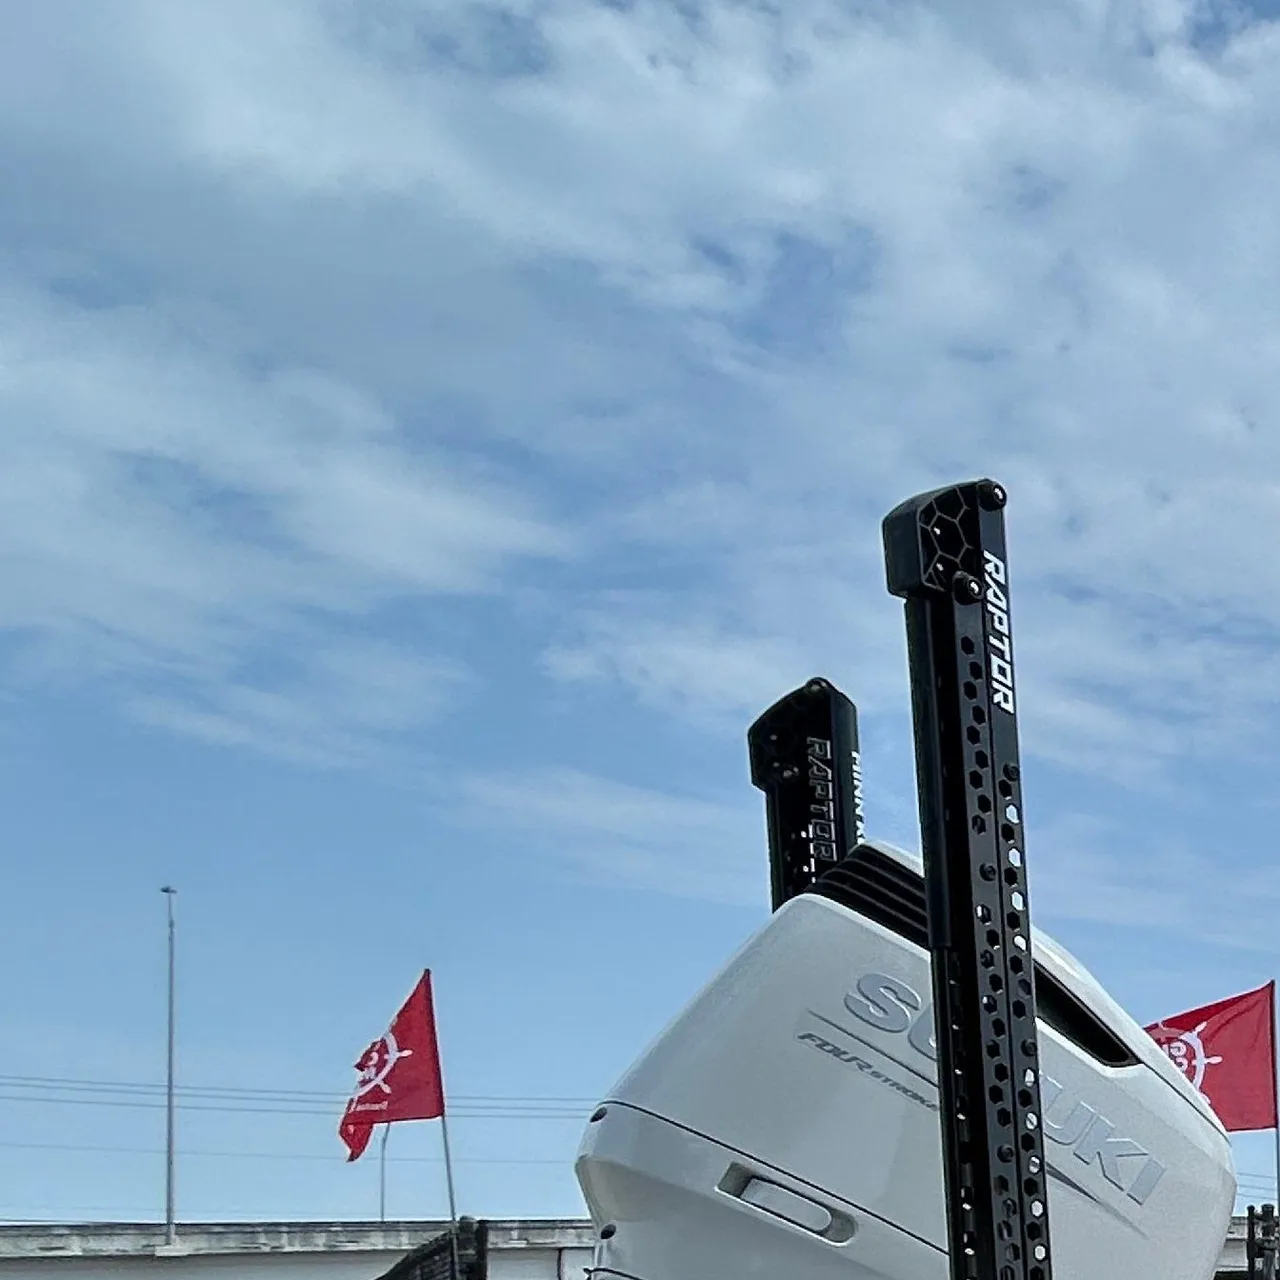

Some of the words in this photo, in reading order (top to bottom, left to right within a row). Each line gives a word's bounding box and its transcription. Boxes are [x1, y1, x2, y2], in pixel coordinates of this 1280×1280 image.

[983, 549, 1015, 714] RAPTOR
[806, 735, 838, 862] RAPTOR
[797, 1032, 873, 1072] FOUR
[843, 971, 1167, 1207] SUKI
